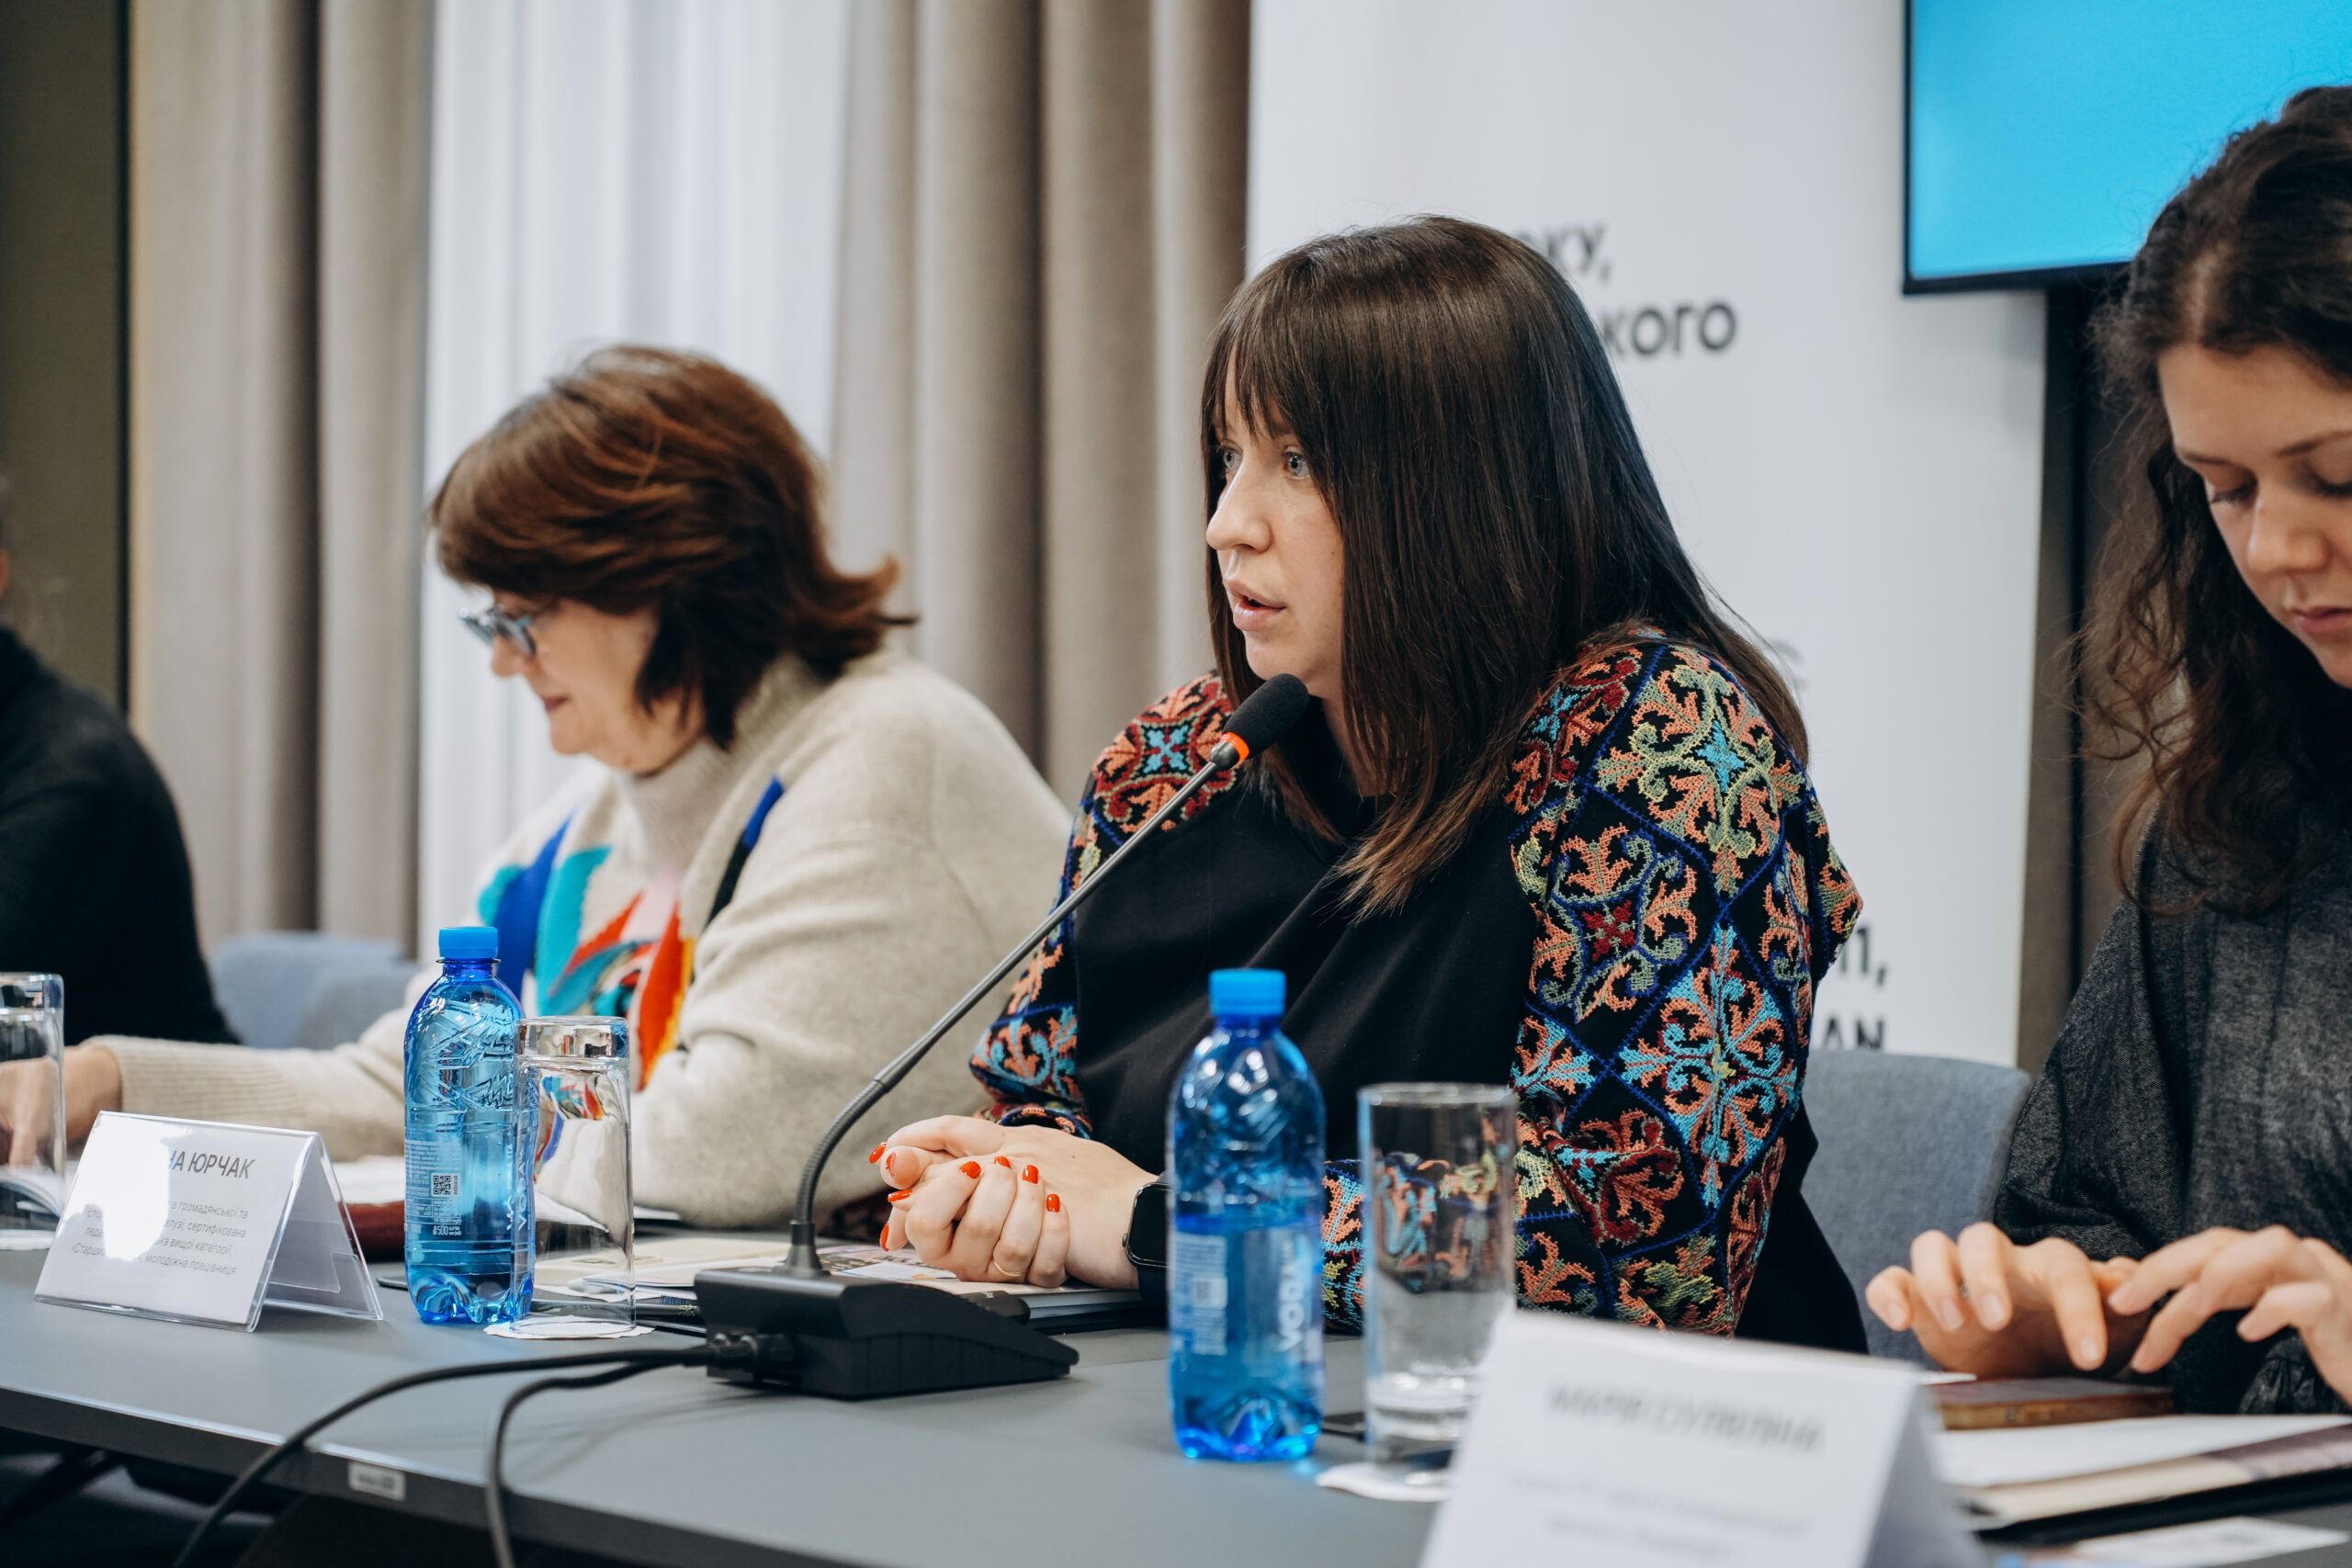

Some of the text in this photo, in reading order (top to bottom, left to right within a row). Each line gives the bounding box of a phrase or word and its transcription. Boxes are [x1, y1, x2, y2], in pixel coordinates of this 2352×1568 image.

[187, 1152, 256, 1179] ЮРЧАК
[239, 1209, 249, 1220] та
[164, 1218, 247, 1238] алузі, сертифікована
